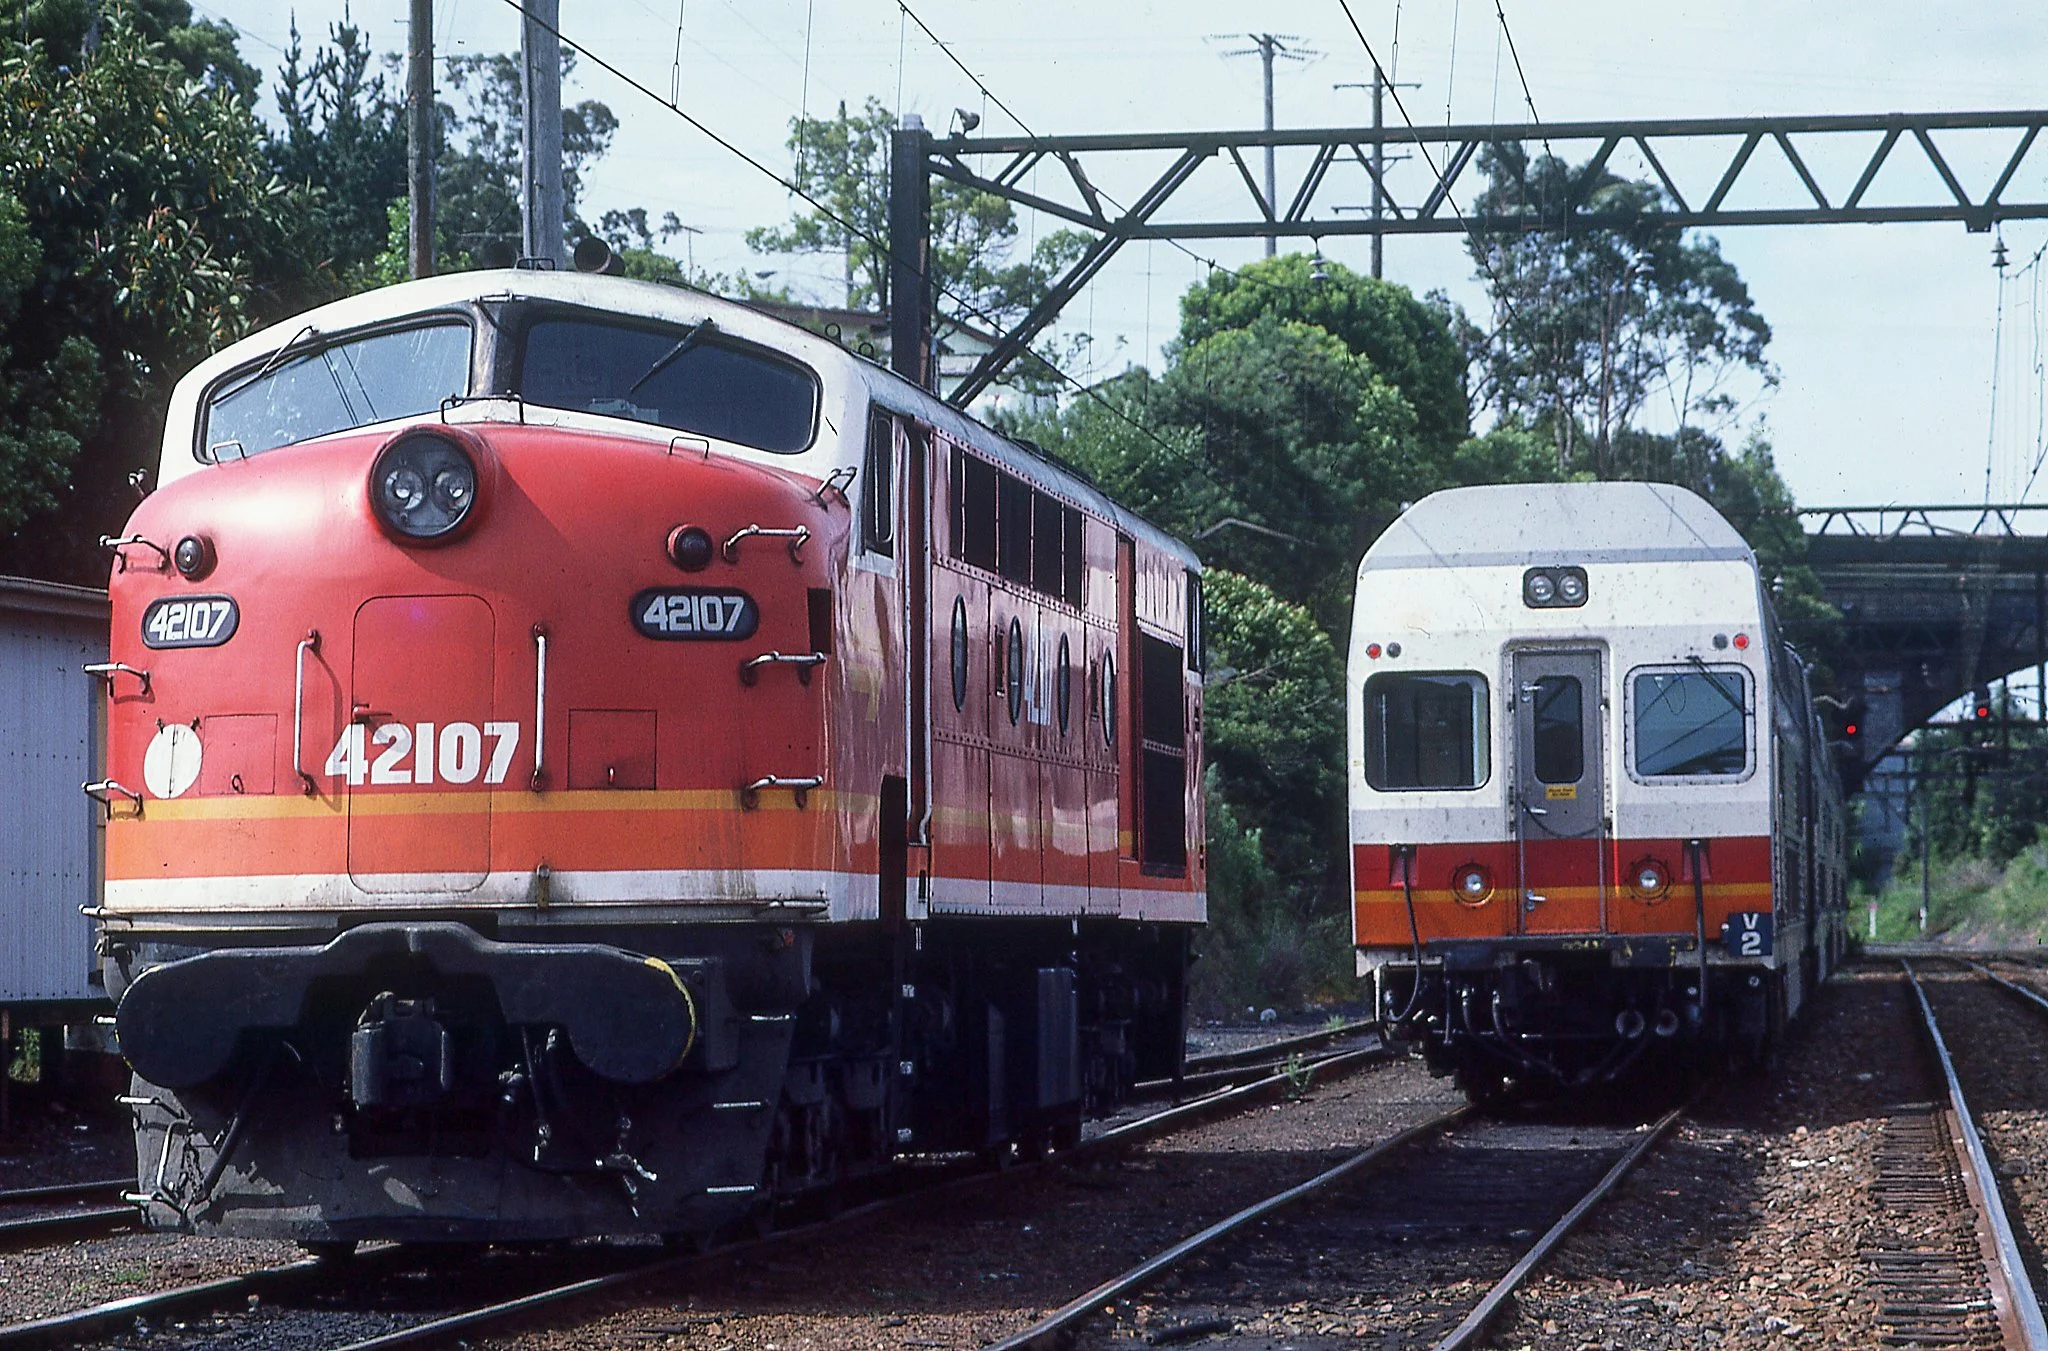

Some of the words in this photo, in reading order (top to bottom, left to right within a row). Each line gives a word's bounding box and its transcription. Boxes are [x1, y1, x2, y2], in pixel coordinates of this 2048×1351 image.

[149, 601, 231, 641] 42107
[643, 595, 744, 632] 42107
[325, 722, 520, 785] 42107
[1742, 913, 1758, 930] V
[1741, 931, 1761, 955] 2
